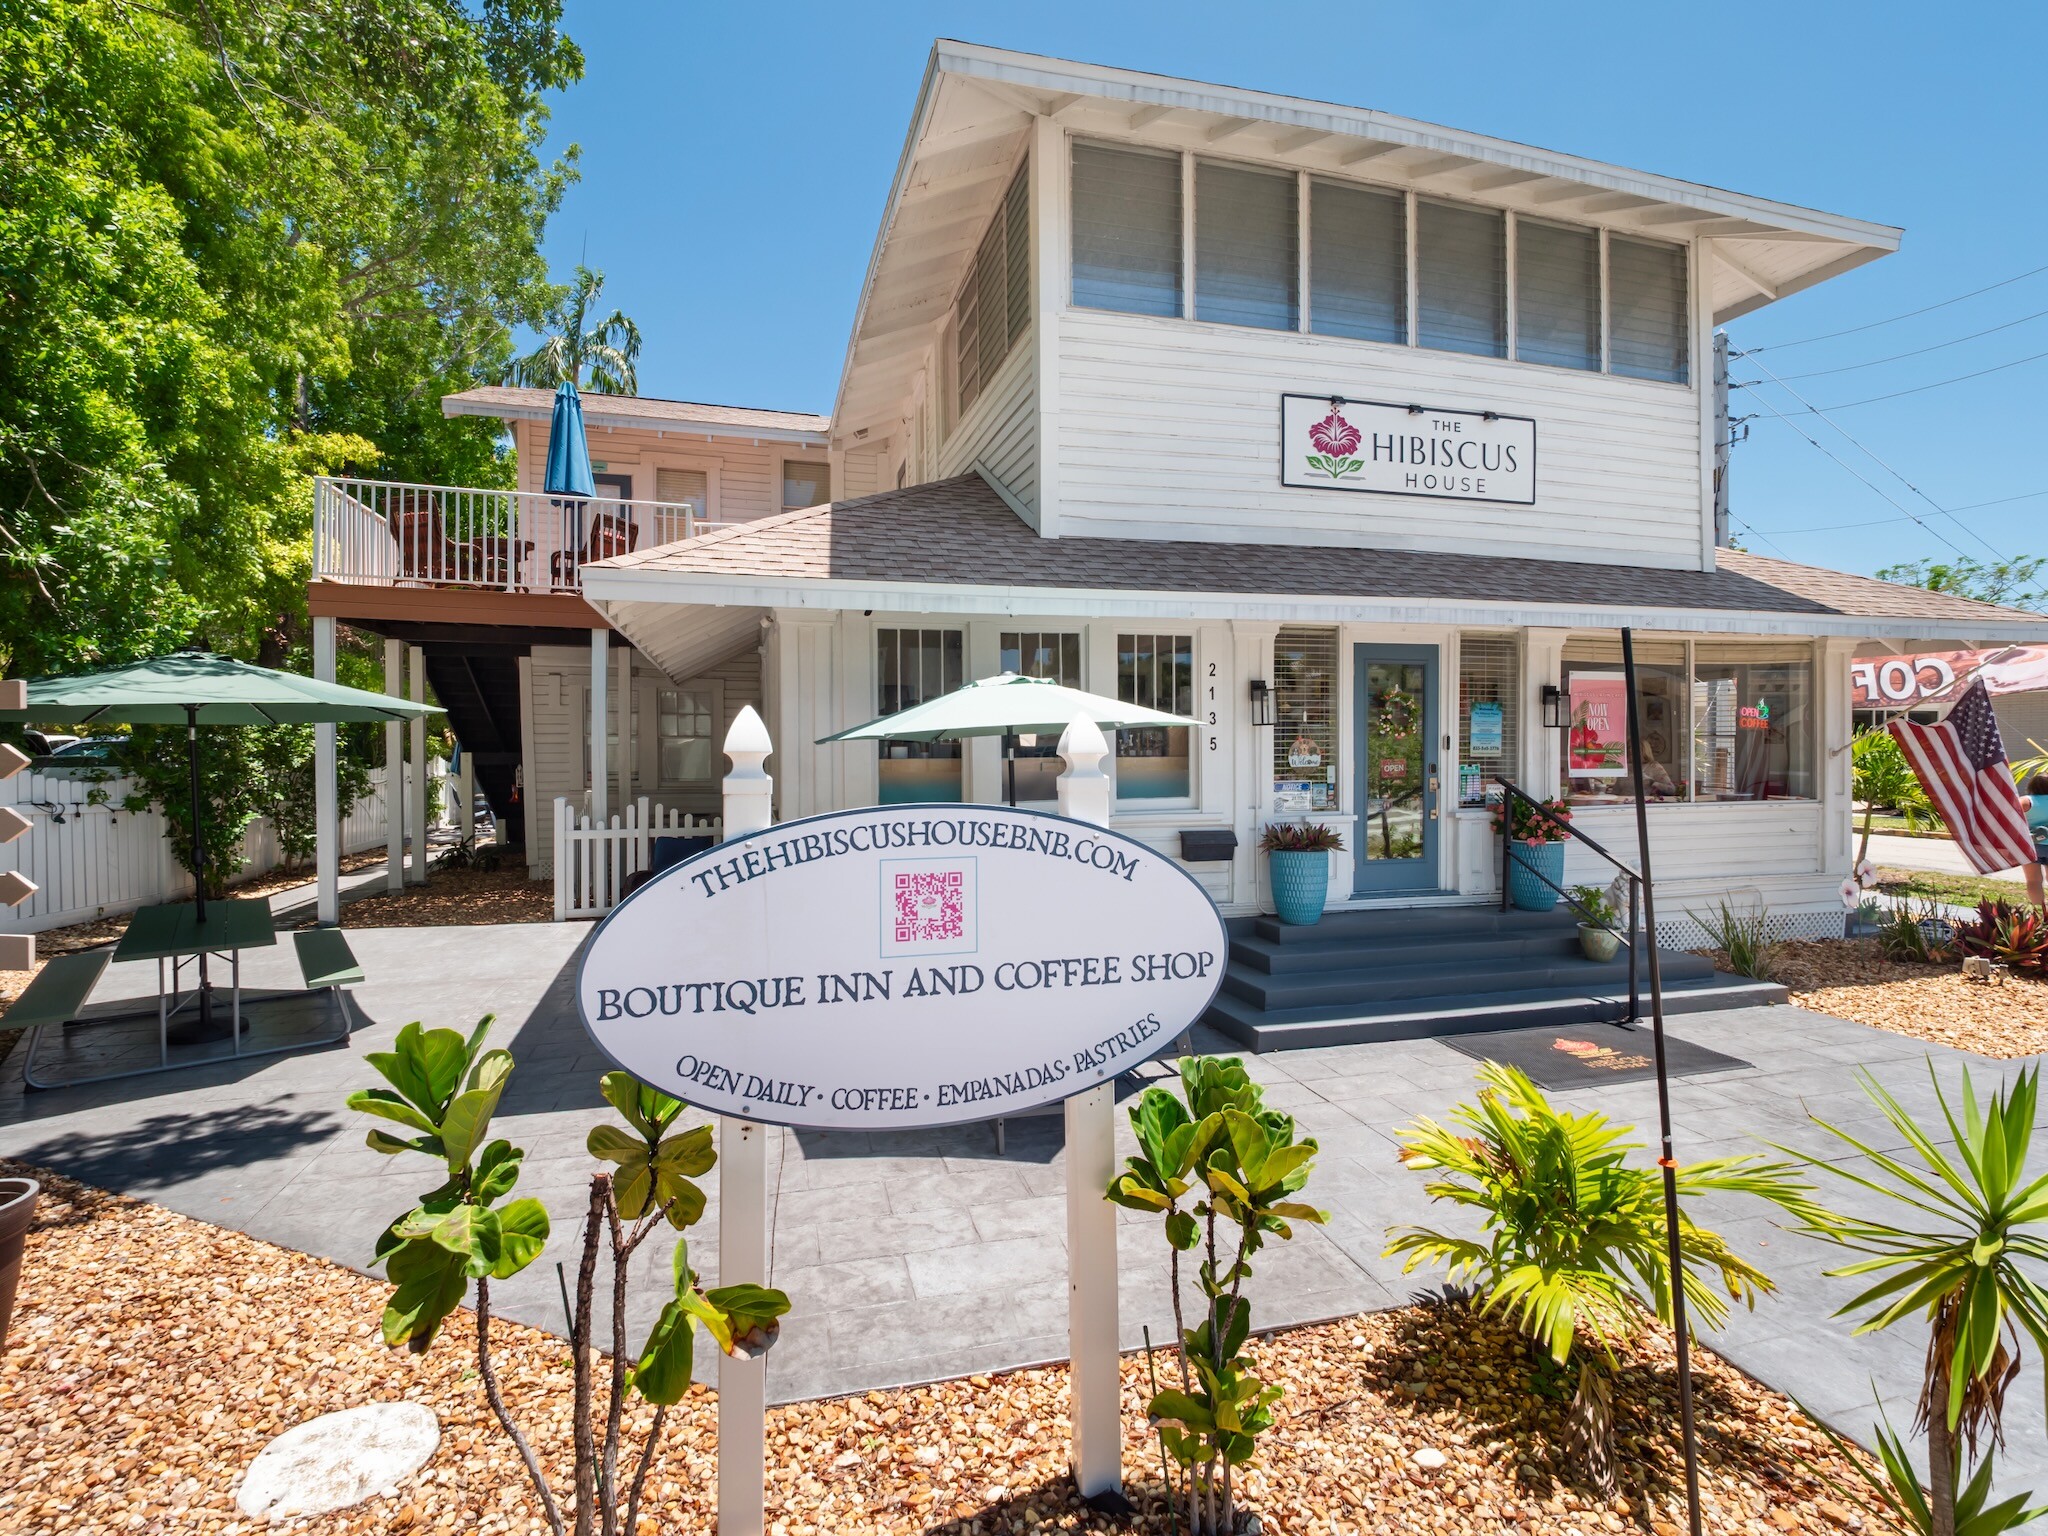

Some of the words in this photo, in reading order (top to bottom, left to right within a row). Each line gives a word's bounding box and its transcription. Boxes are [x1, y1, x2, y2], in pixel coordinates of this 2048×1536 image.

[1433, 420, 1461, 433] THE
[1373, 433, 1517, 473] HIBISCUS
[1405, 473, 1486, 493] HOUSE
[1588, 703, 1608, 716] NOW
[1741, 707, 1758, 716] OPEN
[1587, 717, 1610, 731] OPEN
[1740, 718, 1768, 728] COFFEE
[1384, 764, 1404, 772] OPEN
[691, 820, 1140, 898] THEHIBISCUSHOUSEBNB.COM
[597, 976, 805, 1021] BOUTIQUE
[817, 970, 893, 1004] INN
[903, 964, 985, 998] AND
[994, 956, 1122, 991] COFFEE
[1130, 951, 1214, 983] SHOP
[676, 1055, 744, 1096] OPEN
[742, 1075, 813, 1108] DAILY
[831, 1087, 918, 1111] COFFEE
[937, 1066, 1066, 1107] EMPANADAS
[1072, 1012, 1161, 1074] PASTRIES
